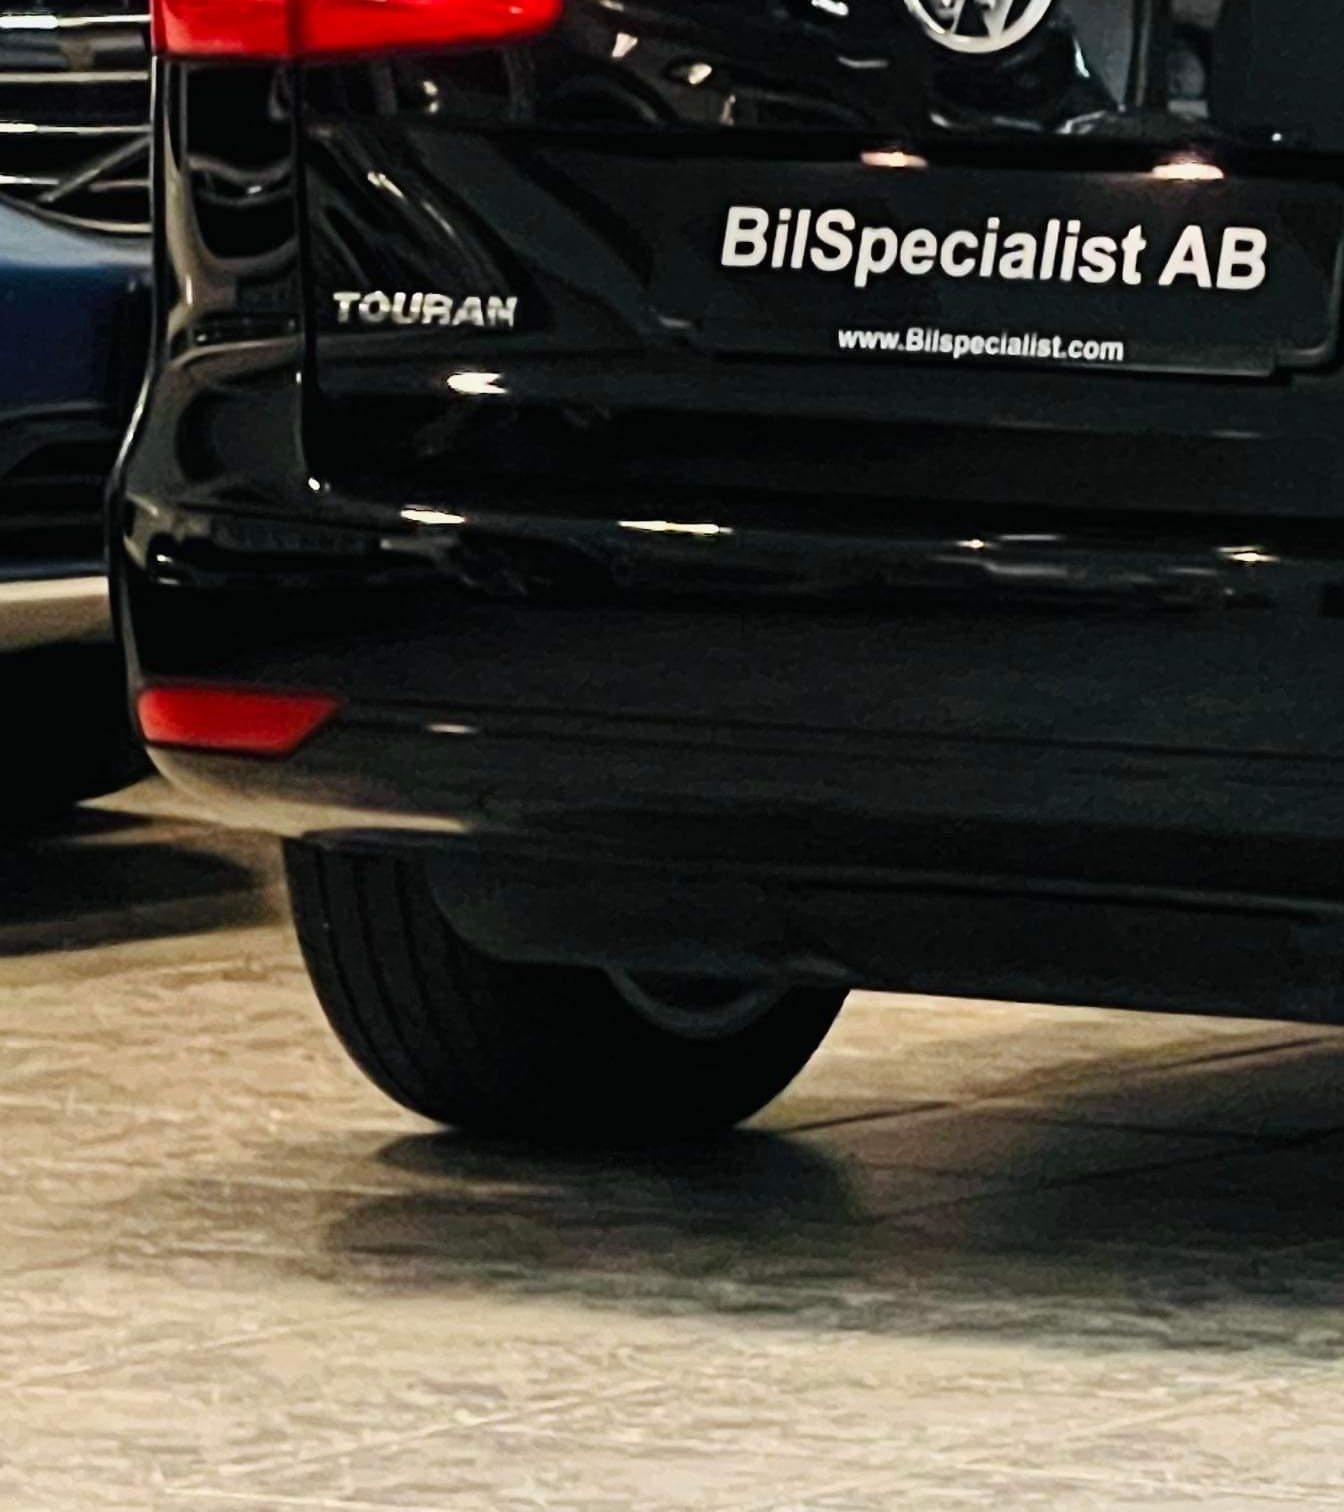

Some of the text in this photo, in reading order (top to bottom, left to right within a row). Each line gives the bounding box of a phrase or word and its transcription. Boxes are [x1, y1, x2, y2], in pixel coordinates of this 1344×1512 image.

[720, 205, 1268, 291] BilSpecialist AB
[332, 290, 519, 328] TOURAN
[837, 327, 1125, 362] www.Bilspecialist.com
